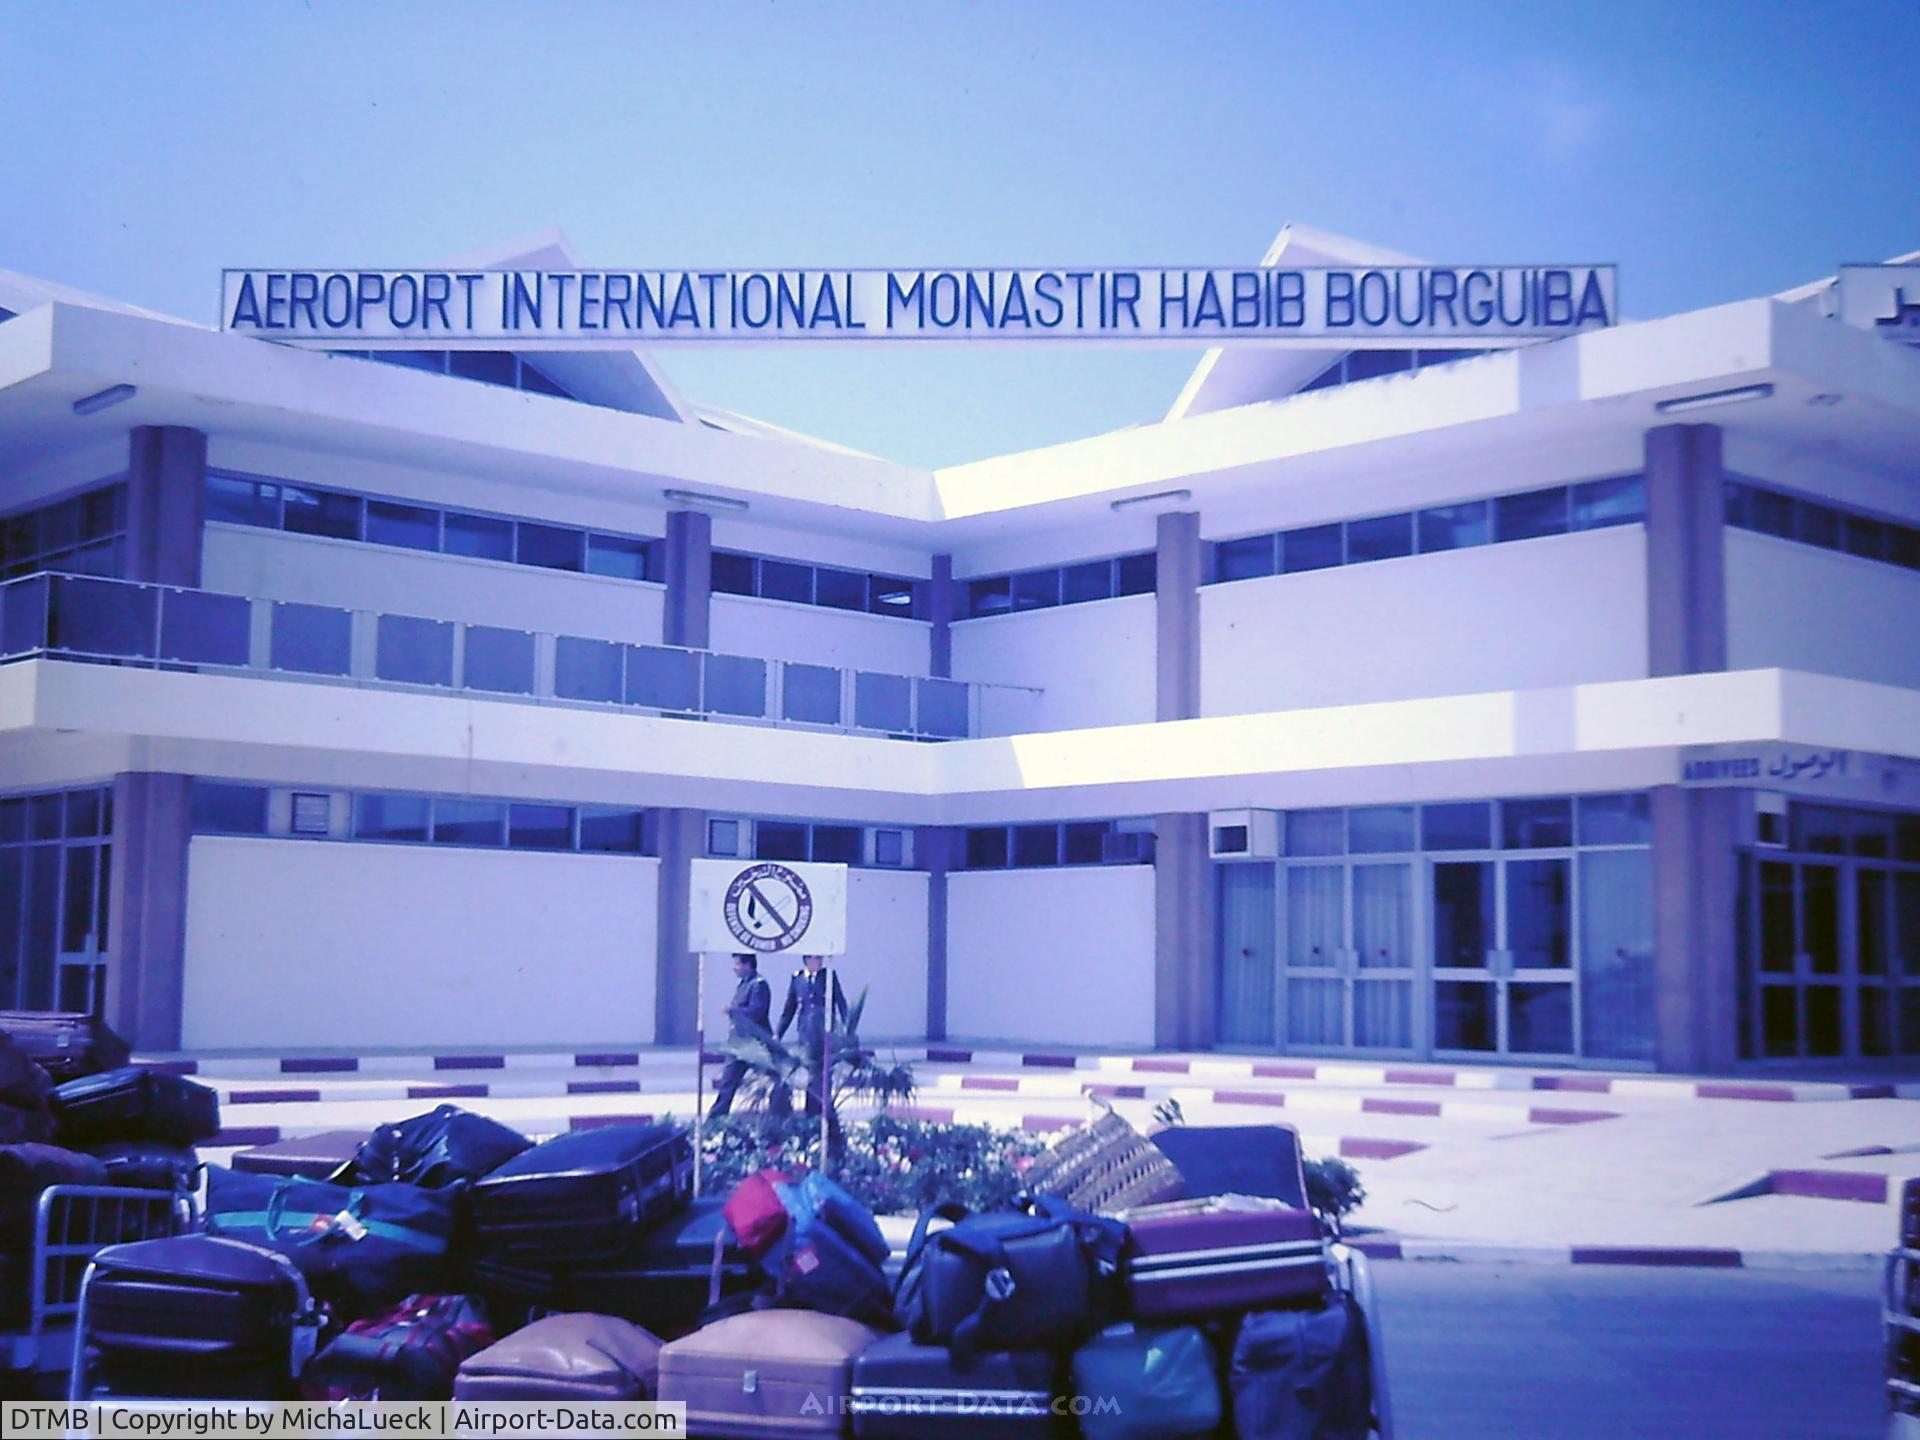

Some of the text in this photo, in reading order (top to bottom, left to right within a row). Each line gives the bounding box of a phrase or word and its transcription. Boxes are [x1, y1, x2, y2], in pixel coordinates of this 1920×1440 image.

[230, 268, 1611, 330] AEROPORT INTERNATIONAL MONASTIR HABIB BOURGUIBA
